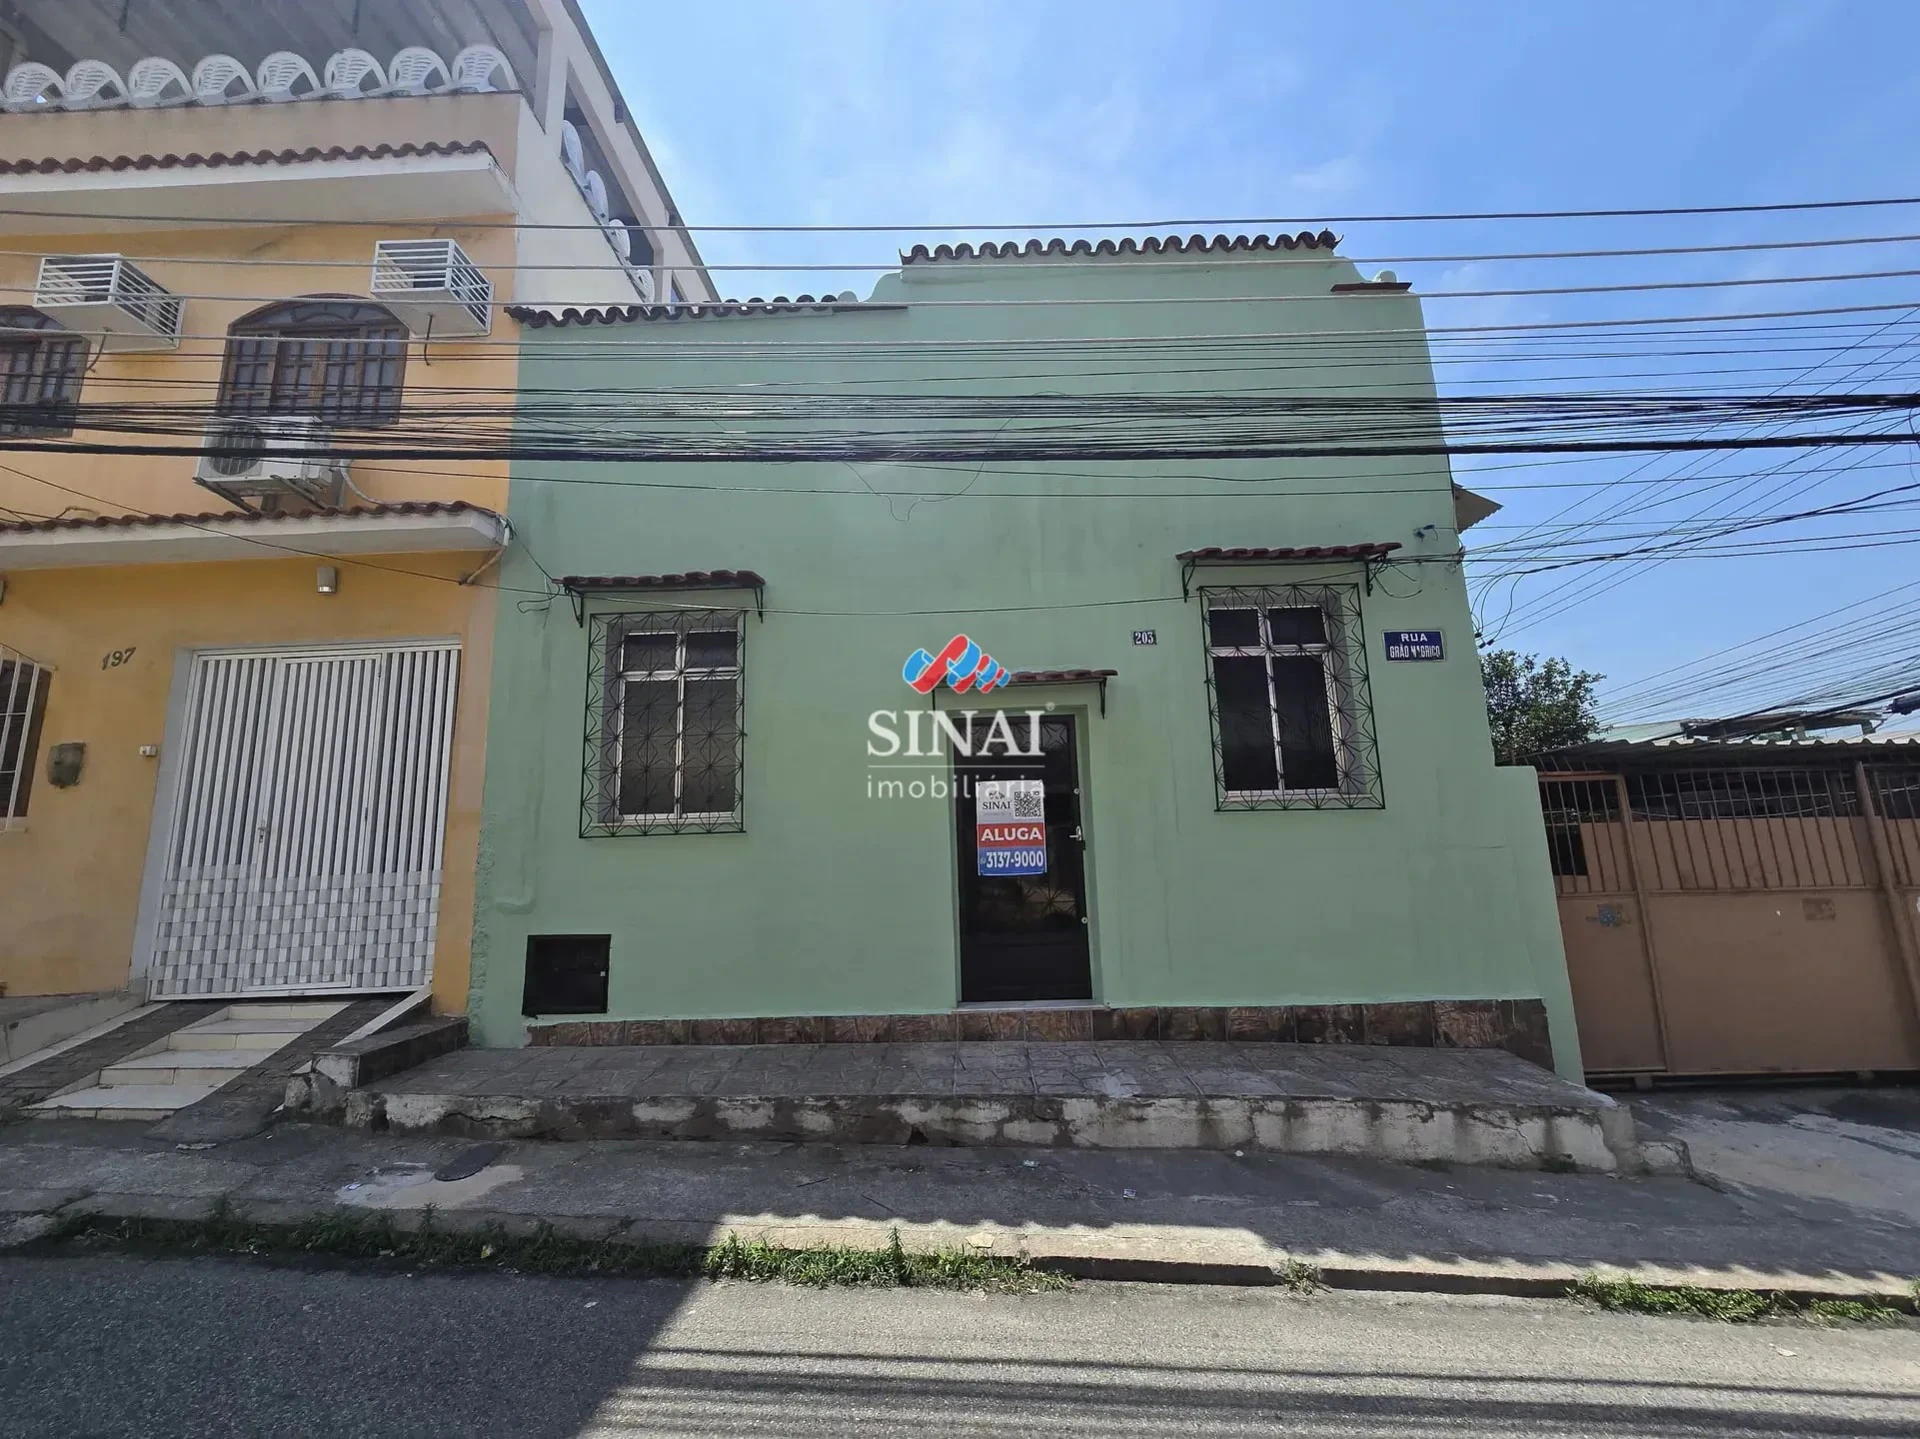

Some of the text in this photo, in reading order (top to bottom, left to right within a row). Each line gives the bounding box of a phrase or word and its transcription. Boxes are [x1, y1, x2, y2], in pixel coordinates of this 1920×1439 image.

[1134, 631, 1154, 644] 203
[1400, 633, 1428, 642] RUA
[102, 646, 137, 670] 197
[982, 801, 1011, 811] SINAI
[981, 827, 1043, 842] ALUGA
[986, 850, 1044, 868] 3137-9000
